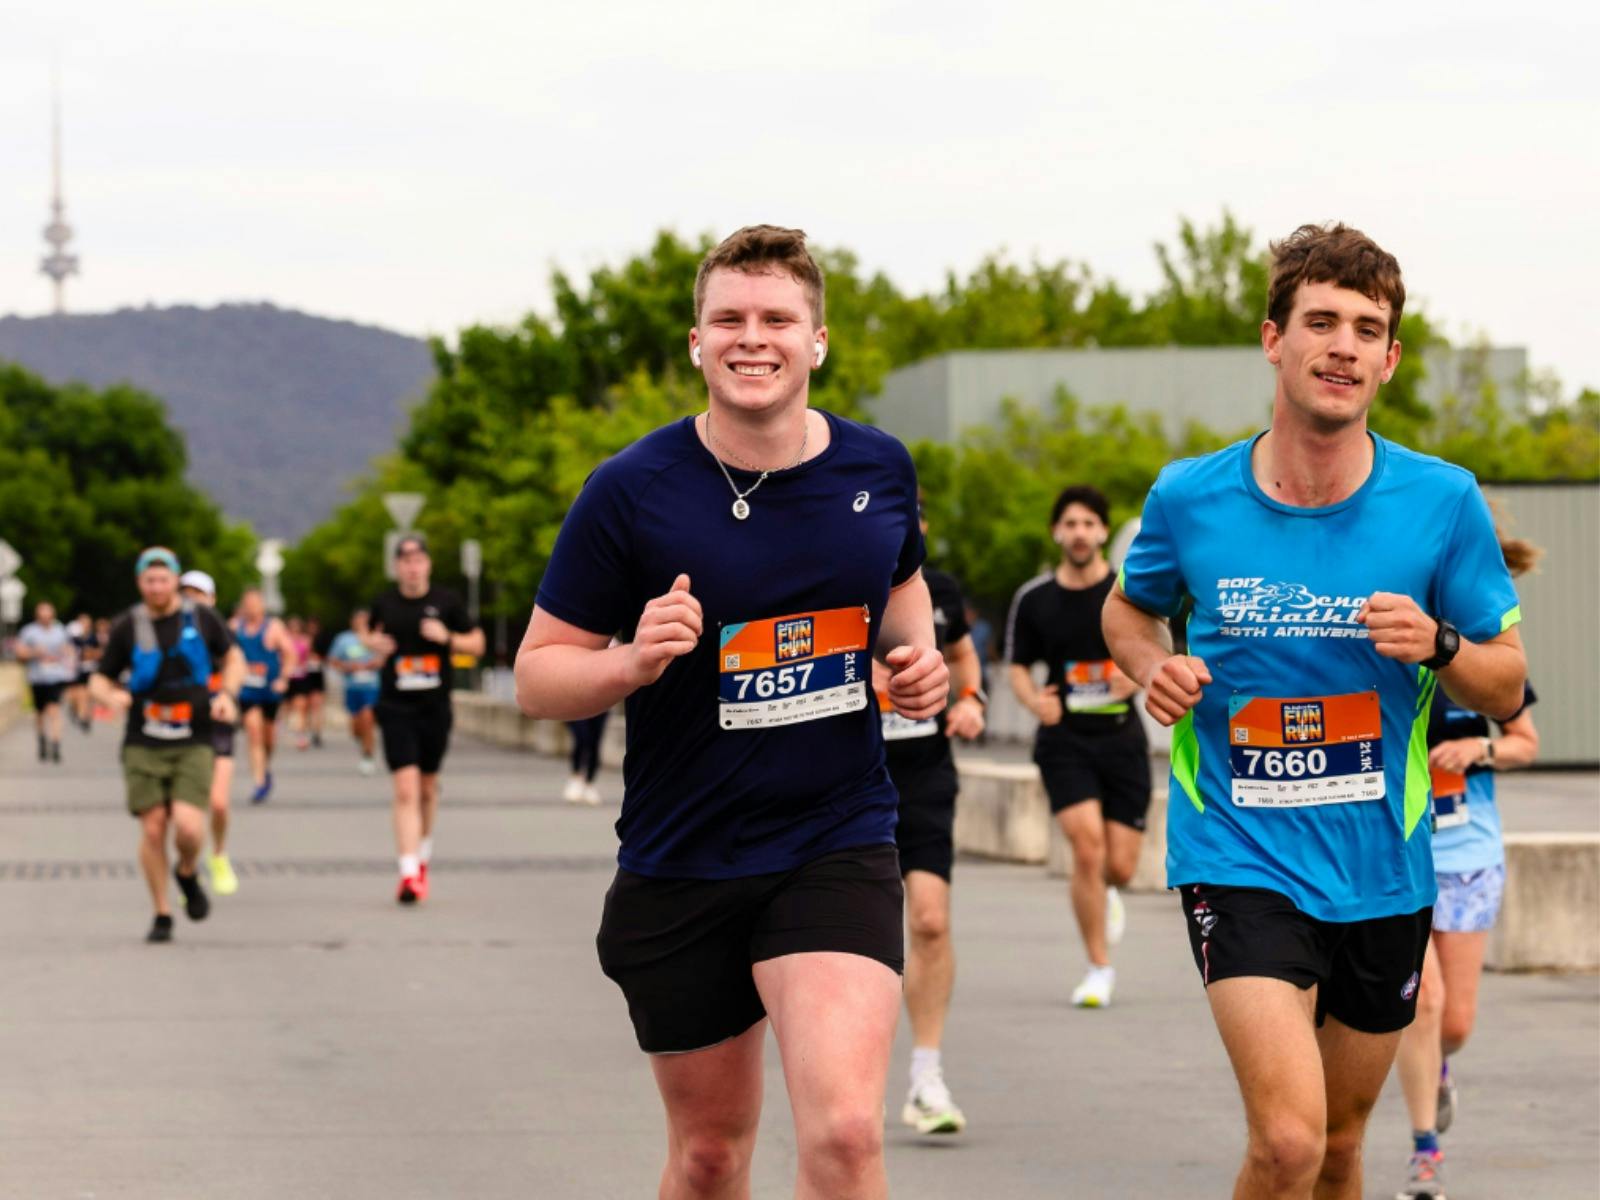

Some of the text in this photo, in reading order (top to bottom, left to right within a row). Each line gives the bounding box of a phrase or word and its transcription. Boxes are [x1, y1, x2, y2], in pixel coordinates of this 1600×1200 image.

[1216, 577, 1264, 589] 2017
[777, 622, 812, 643] FUN
[1220, 626, 1267, 637] 30TH
[778, 638, 812, 659] RUN
[844, 652, 856, 683] 21.1K
[733, 662, 815, 700] 7657
[1284, 708, 1322, 725] FUN
[1285, 723, 1322, 741] RUN
[1243, 749, 1327, 777] 7660
[1359, 741, 1373, 772] 21.1K
